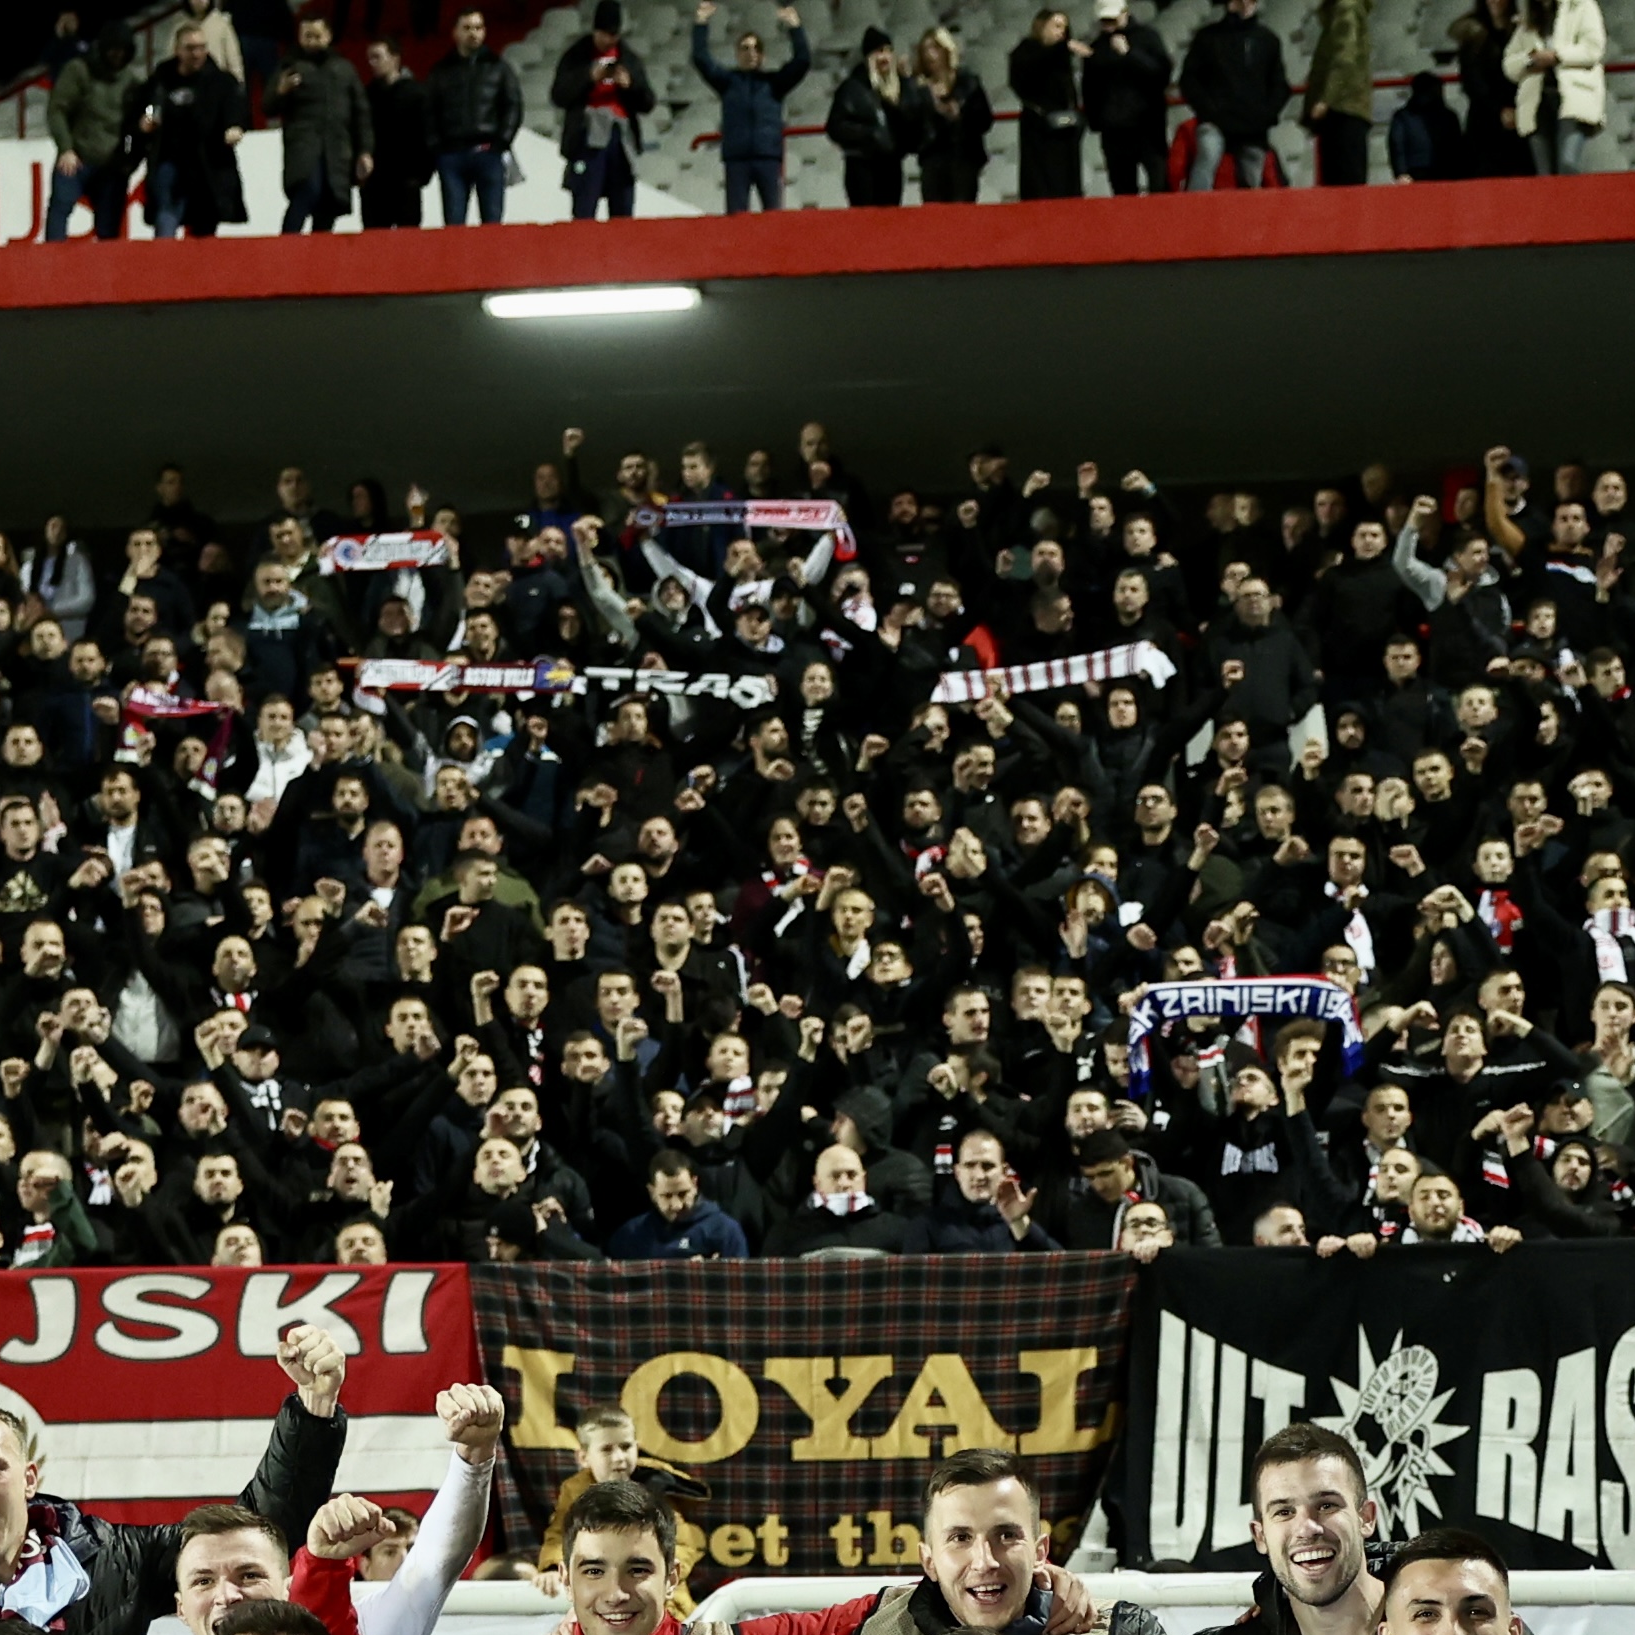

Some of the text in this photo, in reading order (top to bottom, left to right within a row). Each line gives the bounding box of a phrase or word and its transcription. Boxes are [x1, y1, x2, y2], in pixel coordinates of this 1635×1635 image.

[1155, 985, 1311, 1017] ZRINJSKI
[502, 1345, 1113, 1463] LOYAL
[829, 1511, 922, 1568] th
